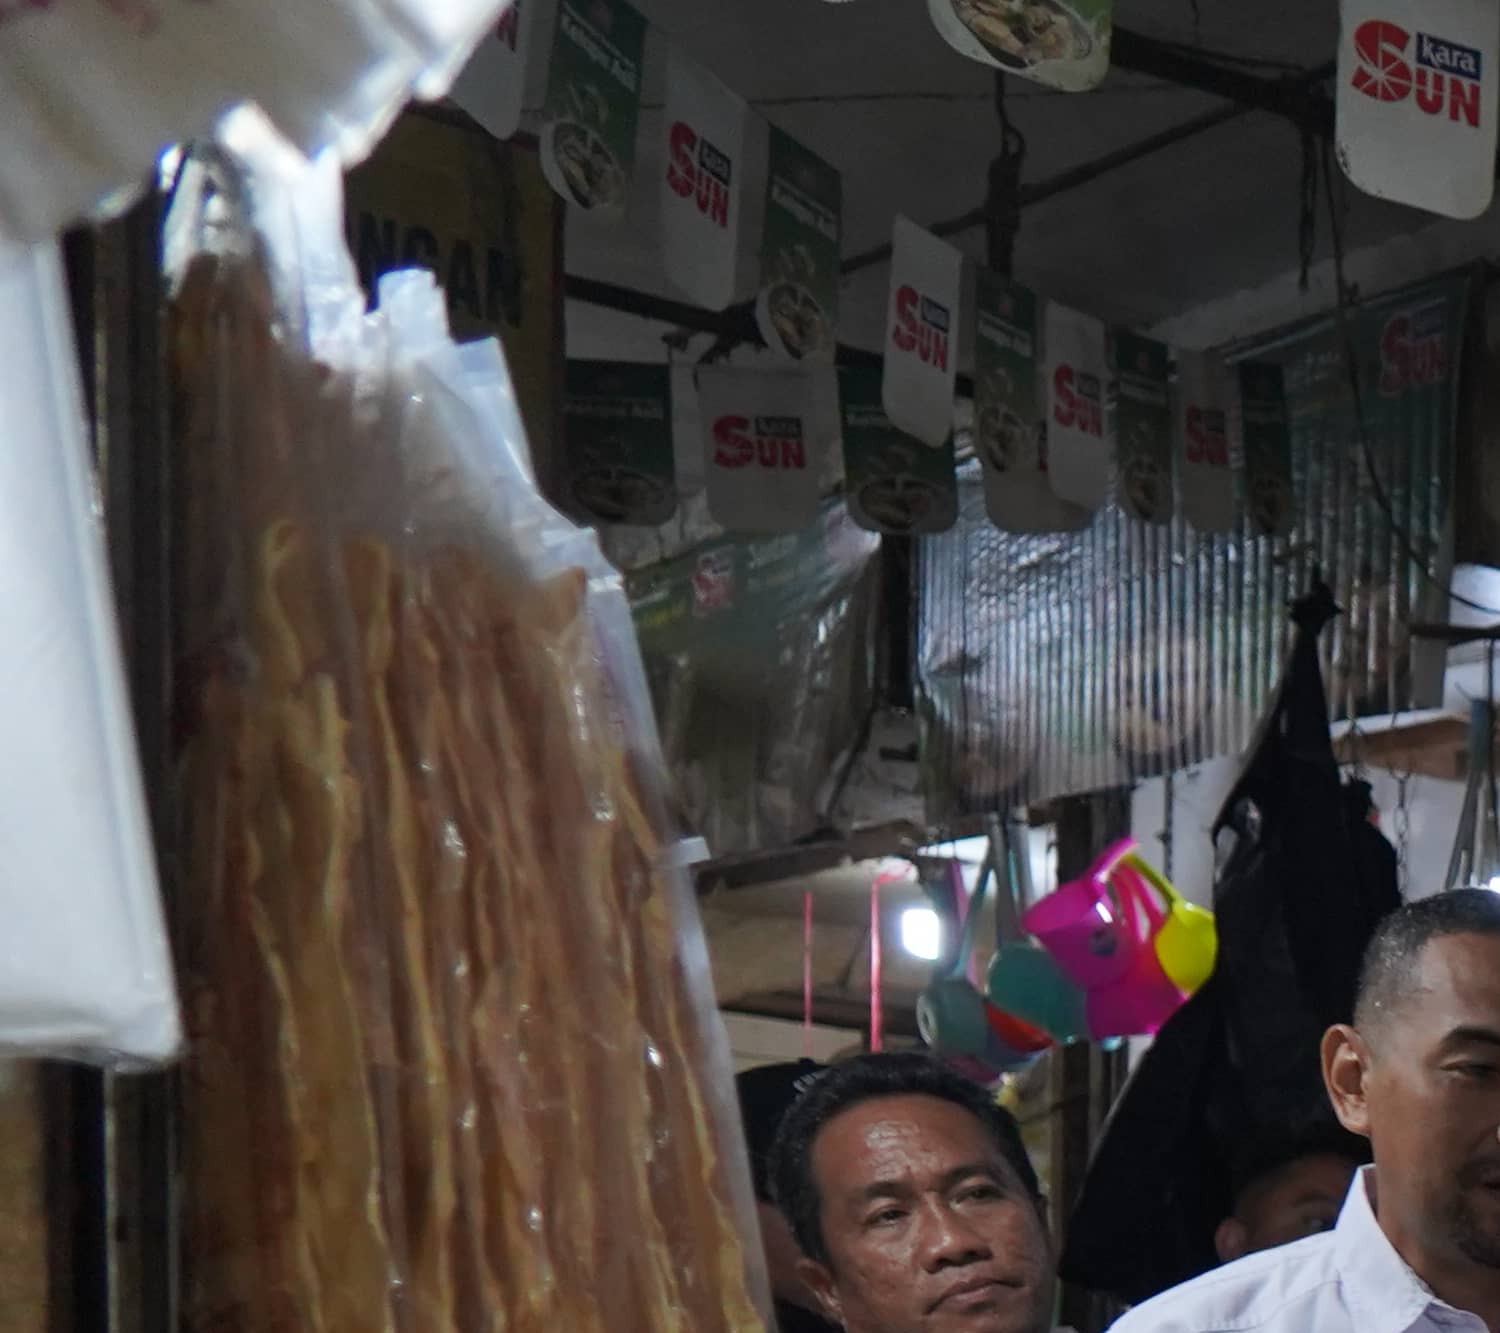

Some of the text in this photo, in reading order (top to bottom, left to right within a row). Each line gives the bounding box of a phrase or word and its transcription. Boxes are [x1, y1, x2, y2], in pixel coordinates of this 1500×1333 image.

[1351, 19, 1481, 128] SUN
[1420, 33, 1477, 75] kara
[666, 120, 729, 228] SUN
[893, 284, 949, 372] SUN
[1054, 364, 1103, 437] SUN
[712, 414, 807, 469] SUN
